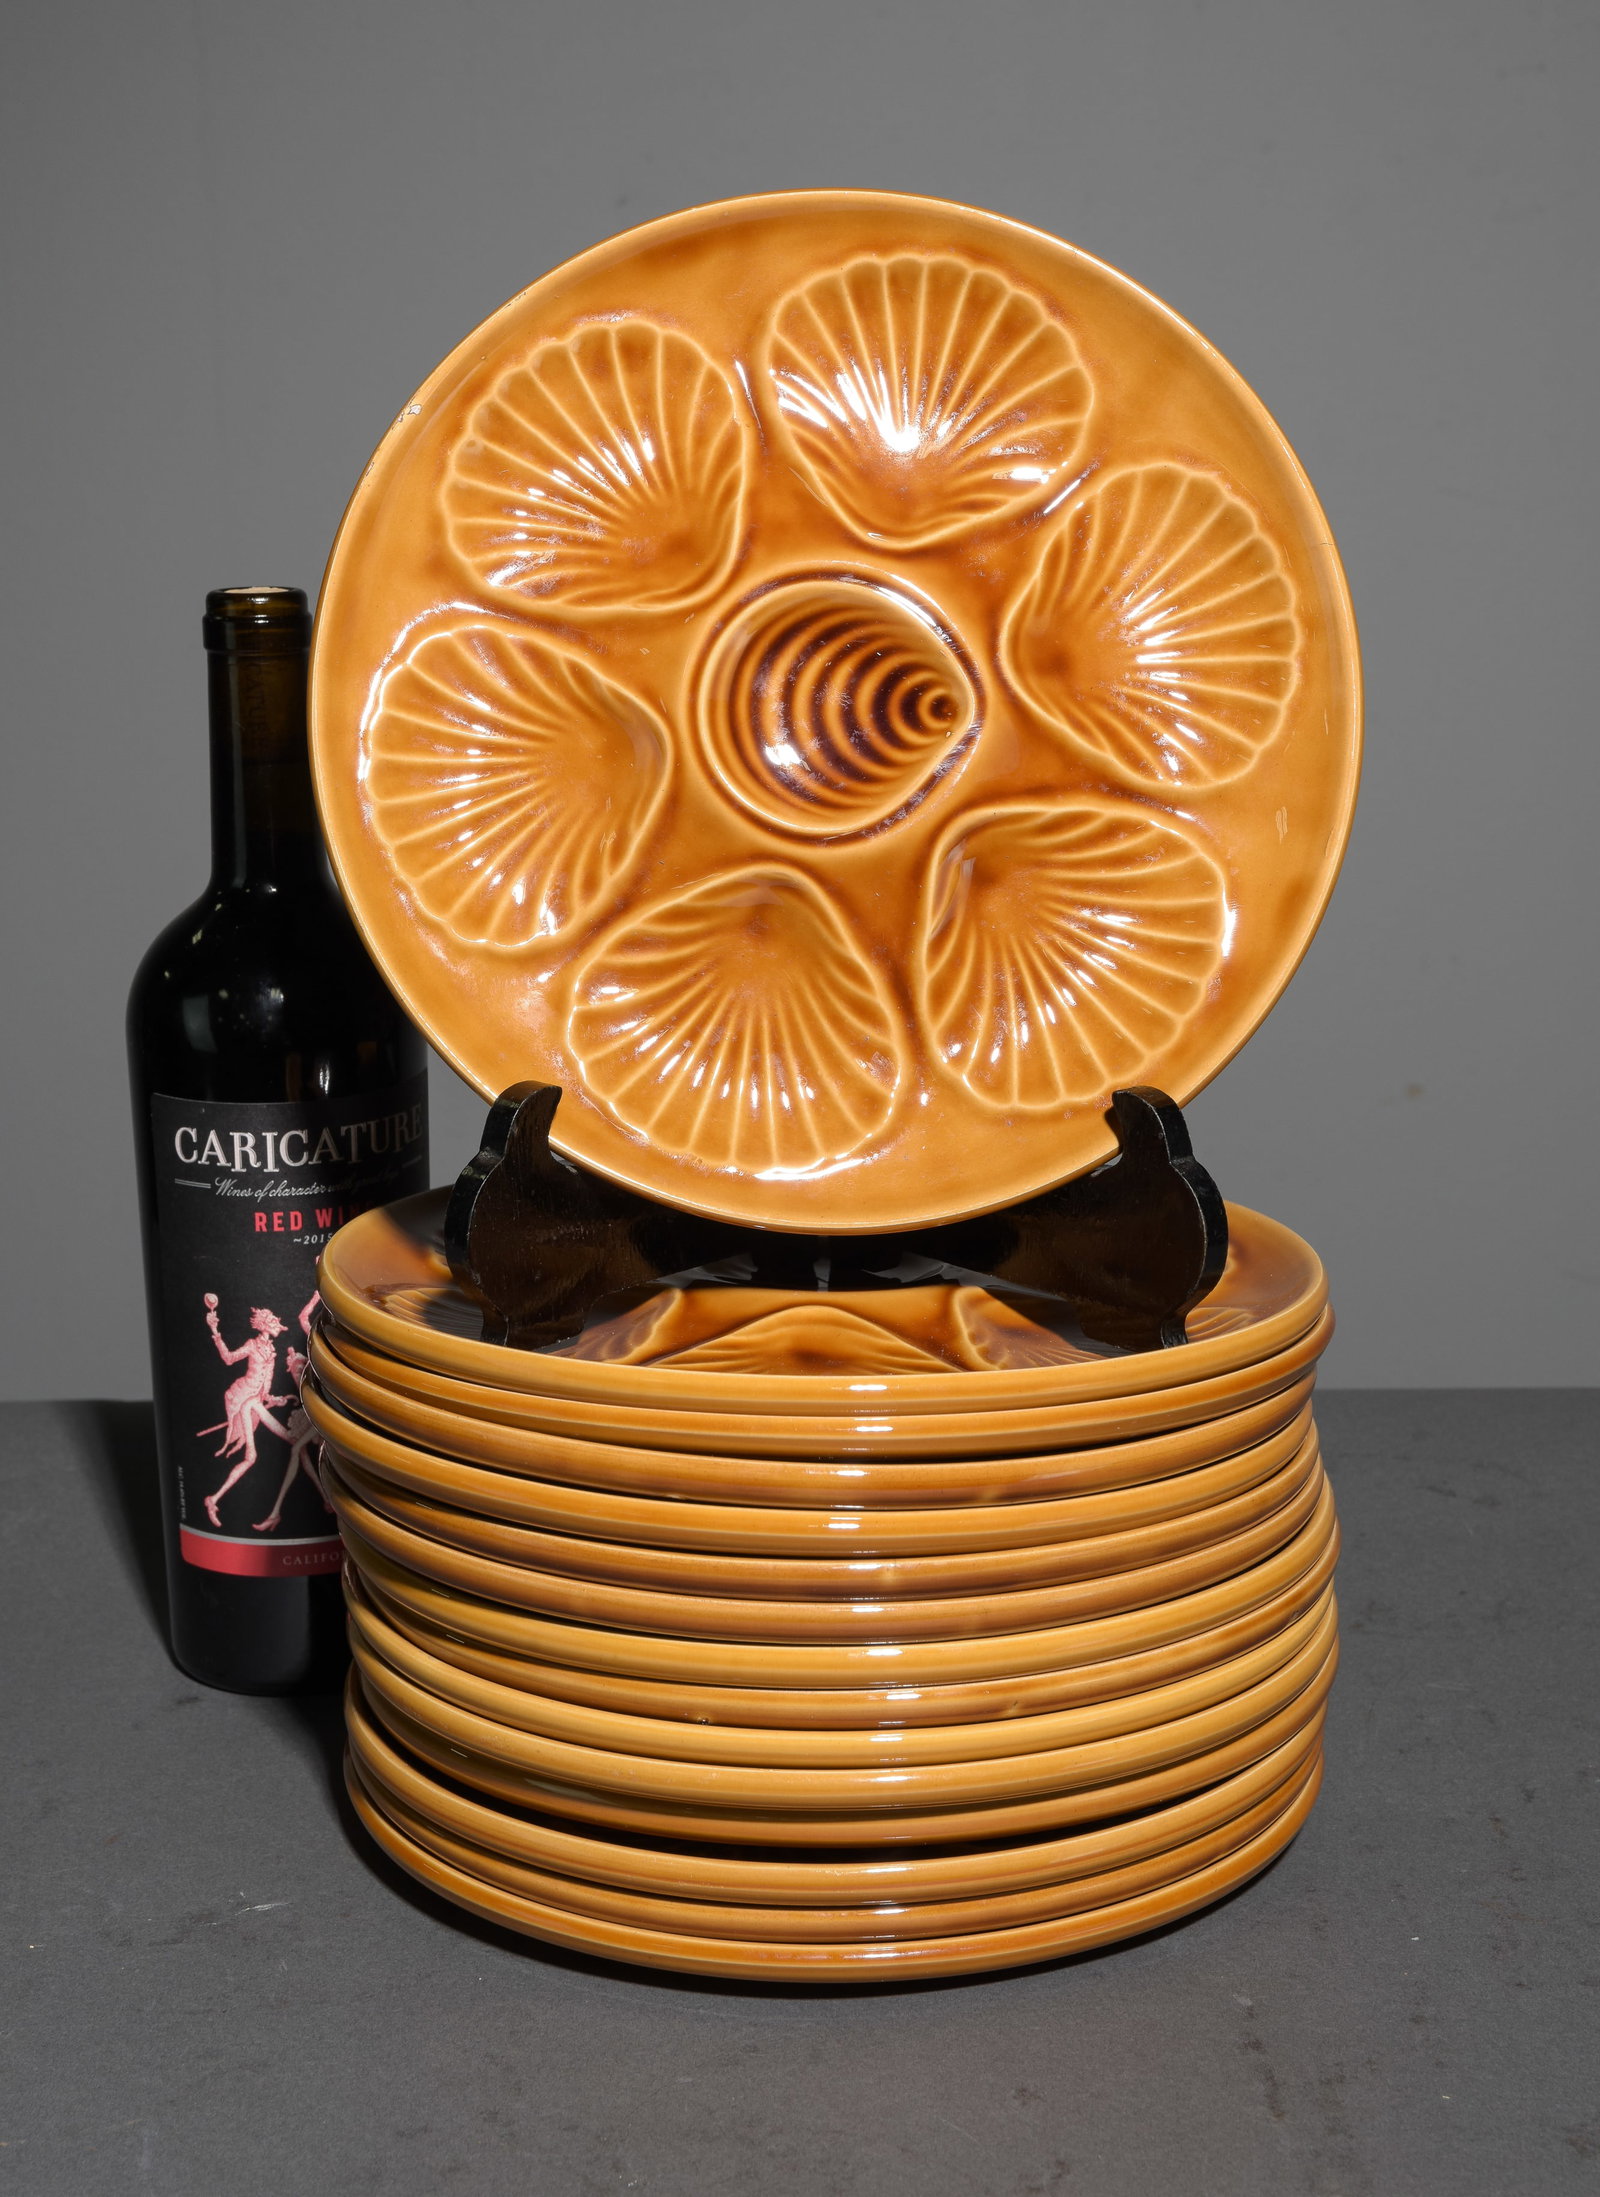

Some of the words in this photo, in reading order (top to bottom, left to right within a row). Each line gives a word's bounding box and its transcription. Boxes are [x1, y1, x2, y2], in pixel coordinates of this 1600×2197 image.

[174, 1103, 423, 1172] CARICATURE
[215, 1177, 253, 1197] Wines
[254, 1180, 275, 1203] of
[269, 1179, 327, 1198] character
[254, 1211, 303, 1233] RED
[282, 1551, 344, 1566] CALIFO
